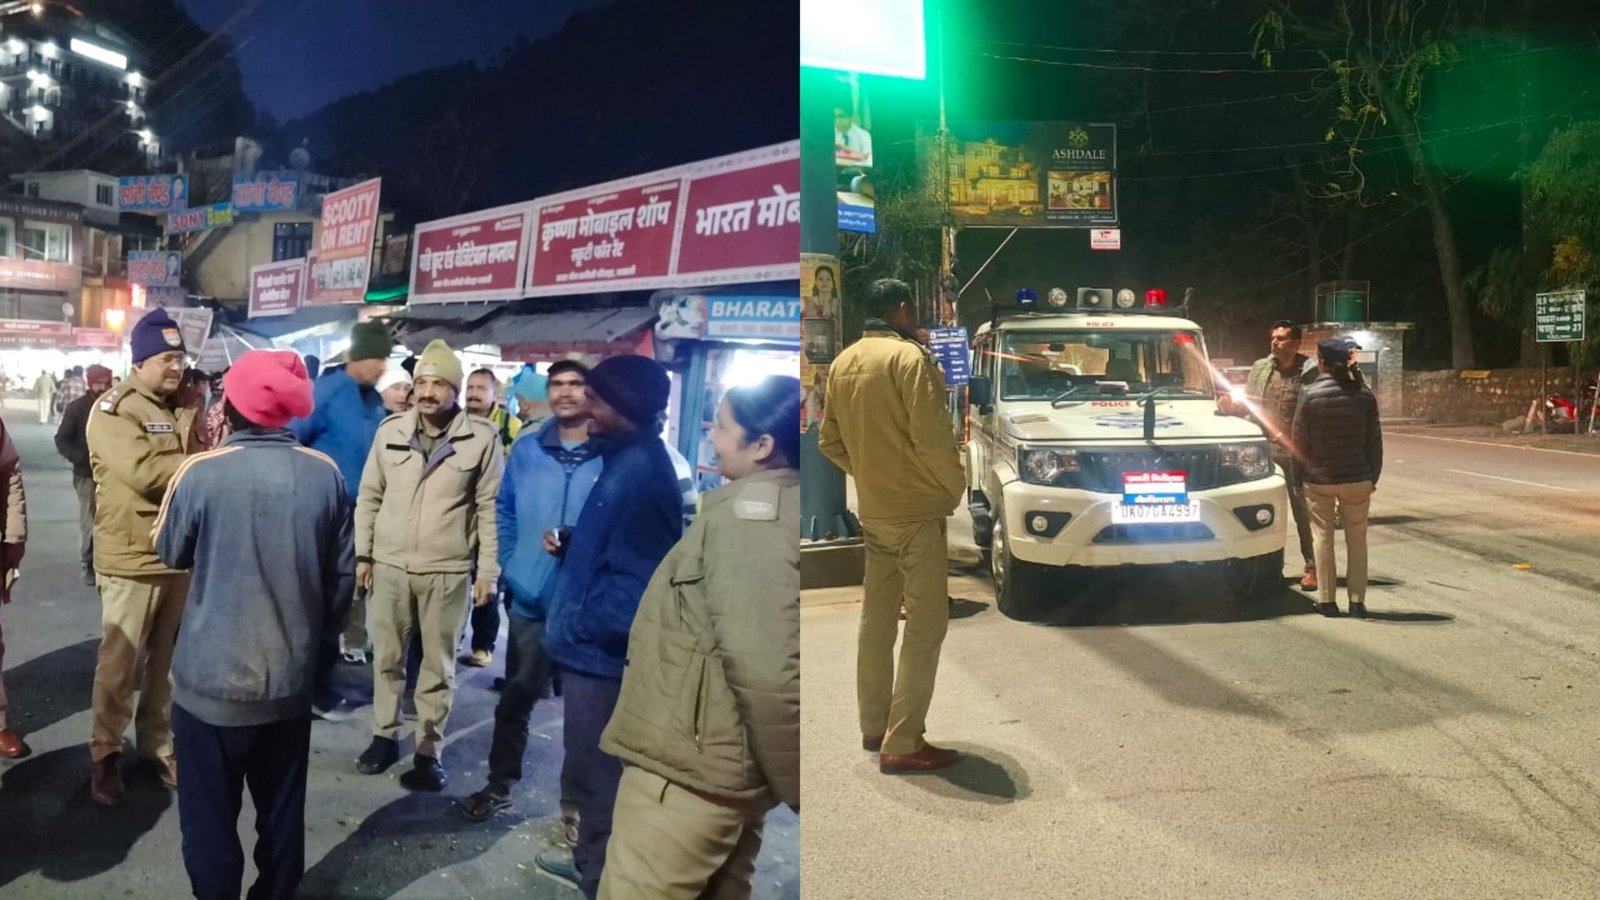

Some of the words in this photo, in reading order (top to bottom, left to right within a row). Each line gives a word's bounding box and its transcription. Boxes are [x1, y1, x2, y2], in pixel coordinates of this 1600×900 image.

[1052, 148, 1106, 160] ASHDALE
[171, 210, 206, 231] SONY
[322, 189, 375, 228] SCOOTY
[696, 200, 754, 236] भारत
[320, 226, 338, 251] ON
[338, 219, 372, 248] RENT
[542, 217, 578, 251] कृष्णा
[579, 207, 635, 238] मोबाइल
[636, 195, 671, 228] शॉप
[712, 301, 800, 317] BHARAT
[1091, 400, 1131, 408] POLICE
